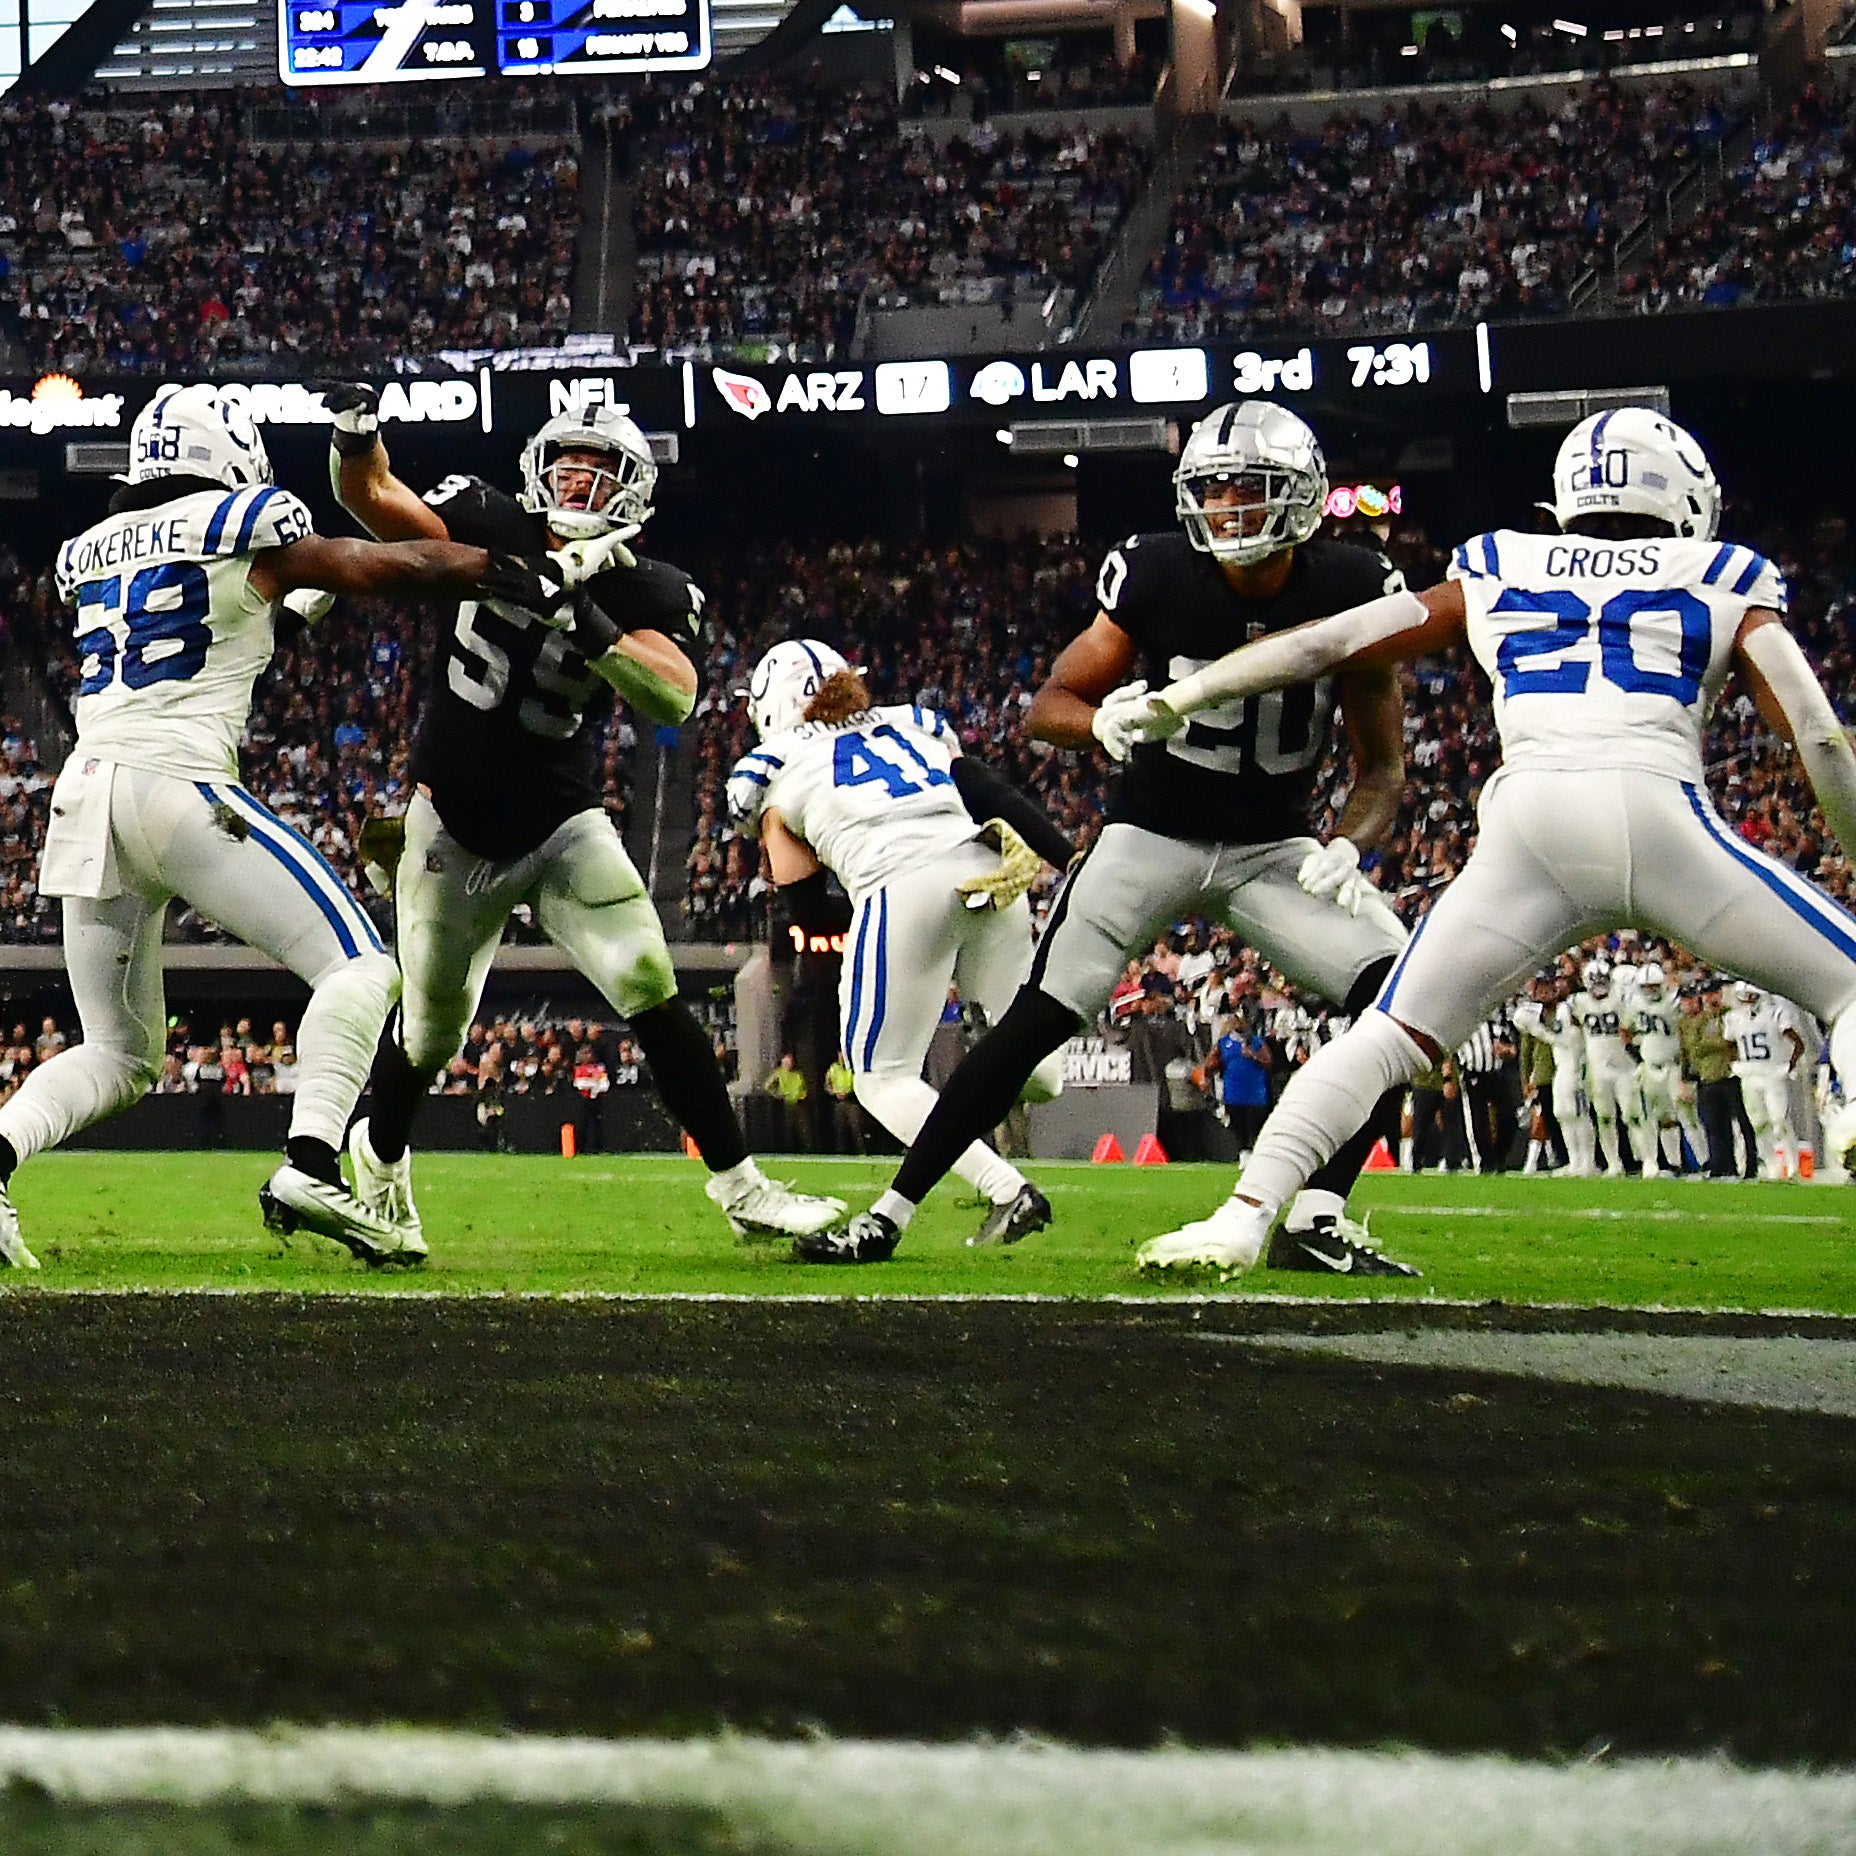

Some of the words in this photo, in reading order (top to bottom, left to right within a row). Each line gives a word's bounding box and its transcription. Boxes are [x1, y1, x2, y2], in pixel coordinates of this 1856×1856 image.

[549, 378, 630, 417] NFL
[777, 371, 865, 413] ARZ
[1030, 361, 1118, 402] LAR
[1233, 349, 1313, 393] 3rd
[1347, 342, 1431, 387] 7:31
[1577, 494, 1620, 508] COLTS
[78, 518, 190, 575] OKEREKE
[1546, 545, 1661, 578] CROSS
[76, 561, 214, 697] 58
[1488, 587, 1711, 705] 20
[832, 724, 955, 798] 41
[1740, 1032, 1771, 1061] 15
